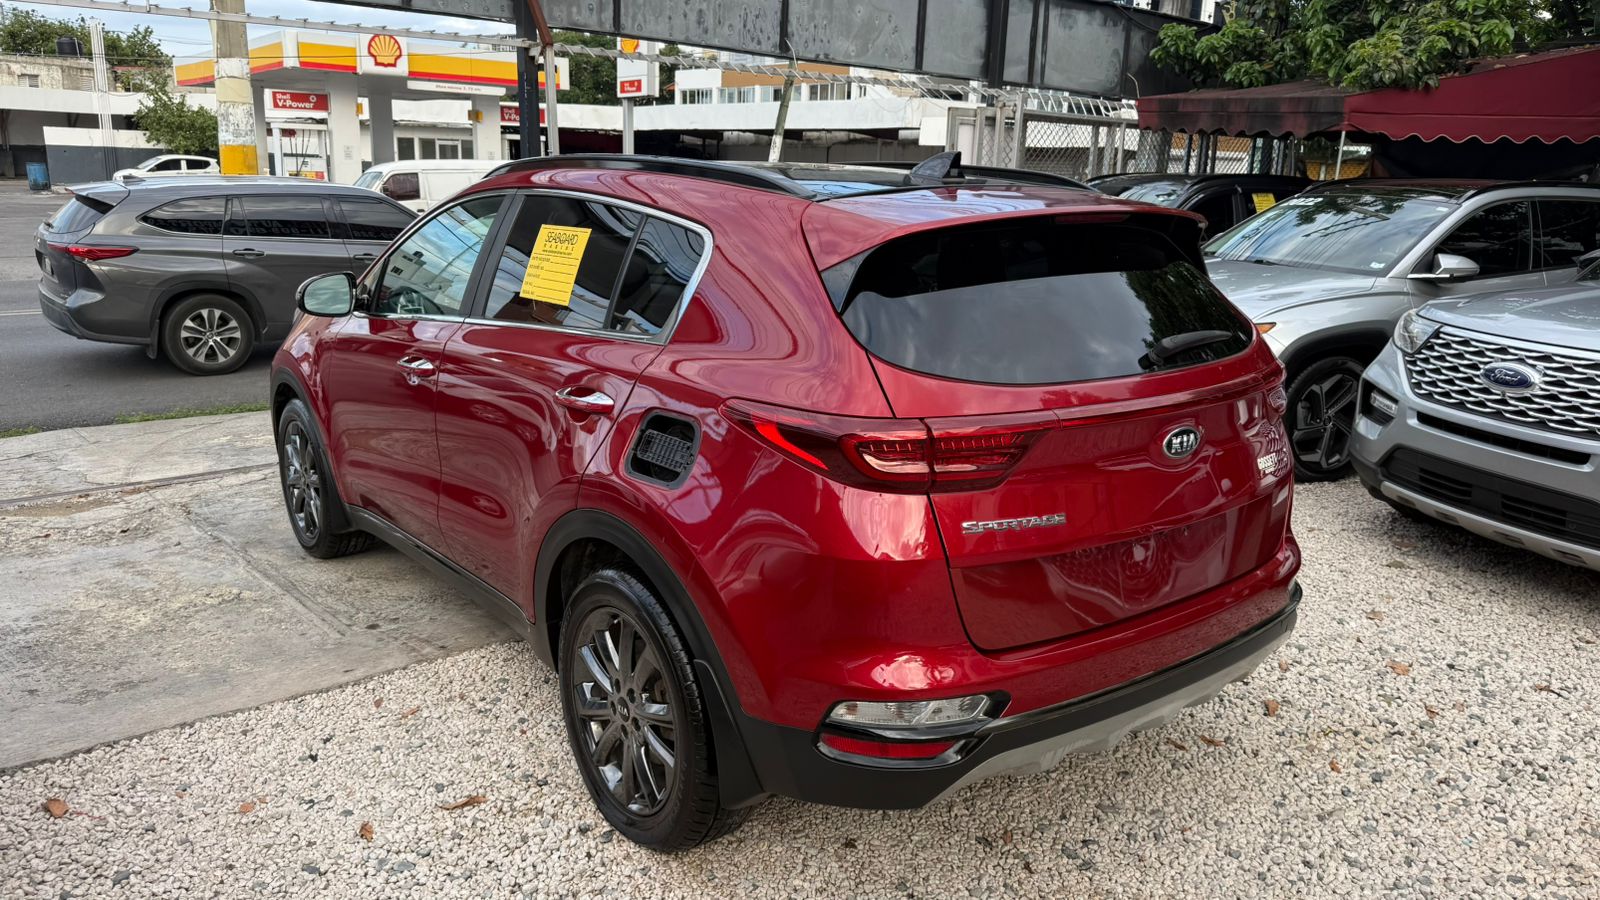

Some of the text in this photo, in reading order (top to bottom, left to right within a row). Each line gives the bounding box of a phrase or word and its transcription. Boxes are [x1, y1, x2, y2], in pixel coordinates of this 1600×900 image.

[276, 99, 314, 109] V-Power
[544, 231, 579, 246] SEABOARD
[1490, 368, 1521, 383] Ford
[1171, 432, 1196, 454] KIA
[961, 512, 1067, 535] SPORTAGE
